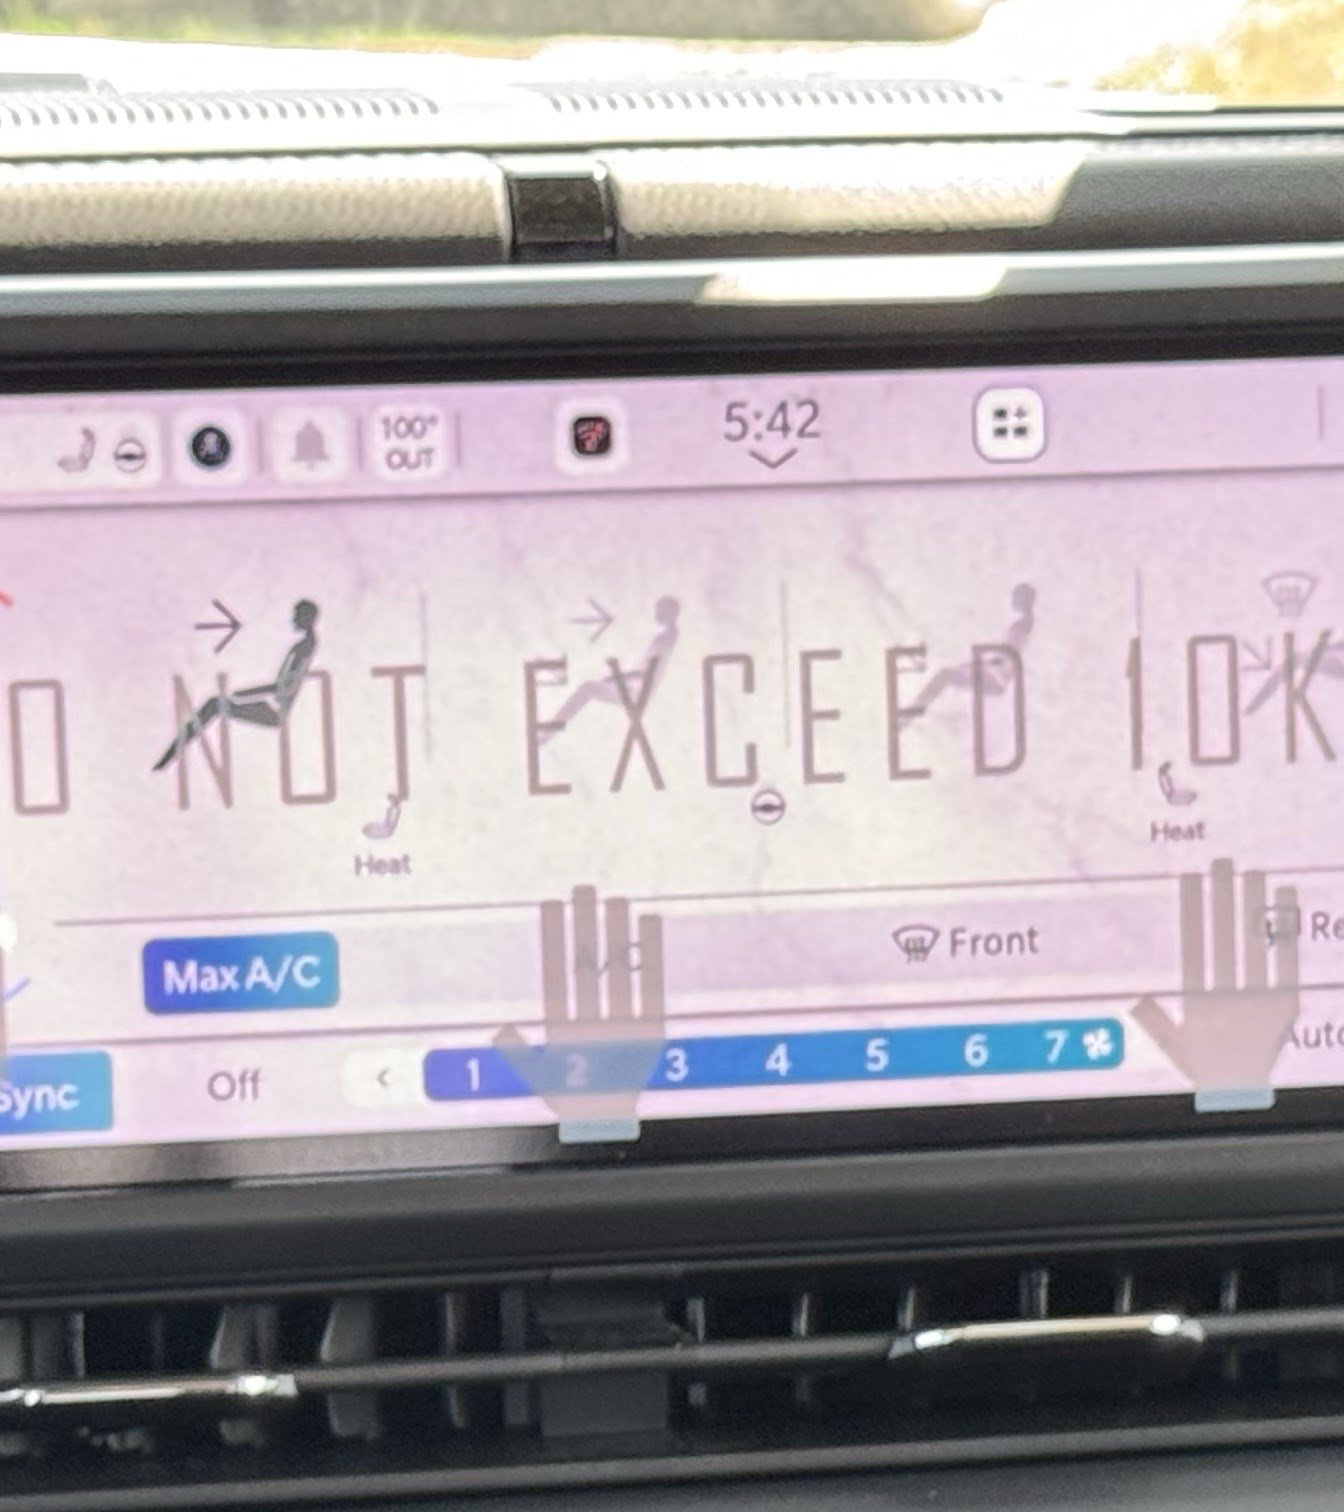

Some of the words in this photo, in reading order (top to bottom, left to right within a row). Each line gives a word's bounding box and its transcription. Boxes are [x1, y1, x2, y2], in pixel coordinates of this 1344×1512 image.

[723, 400, 821, 442] 5:42
[386, 447, 434, 471] OUT
[524, 645, 1027, 794] EXCEED
[1149, 820, 1205, 843] Heat
[356, 851, 411, 876] Heat
[949, 925, 1040, 958] Front
[163, 961, 238, 994] Max
[246, 956, 322, 994] A/C
[466, 1058, 480, 1091] 1
[565, 1053, 589, 1088] 2
[665, 1048, 689, 1082] 3
[765, 1043, 792, 1075] 4
[865, 1038, 889, 1071] 5
[965, 1034, 989, 1067] 6
[1045, 1030, 1066, 1064] 7
[207, 1069, 262, 1102] Off
